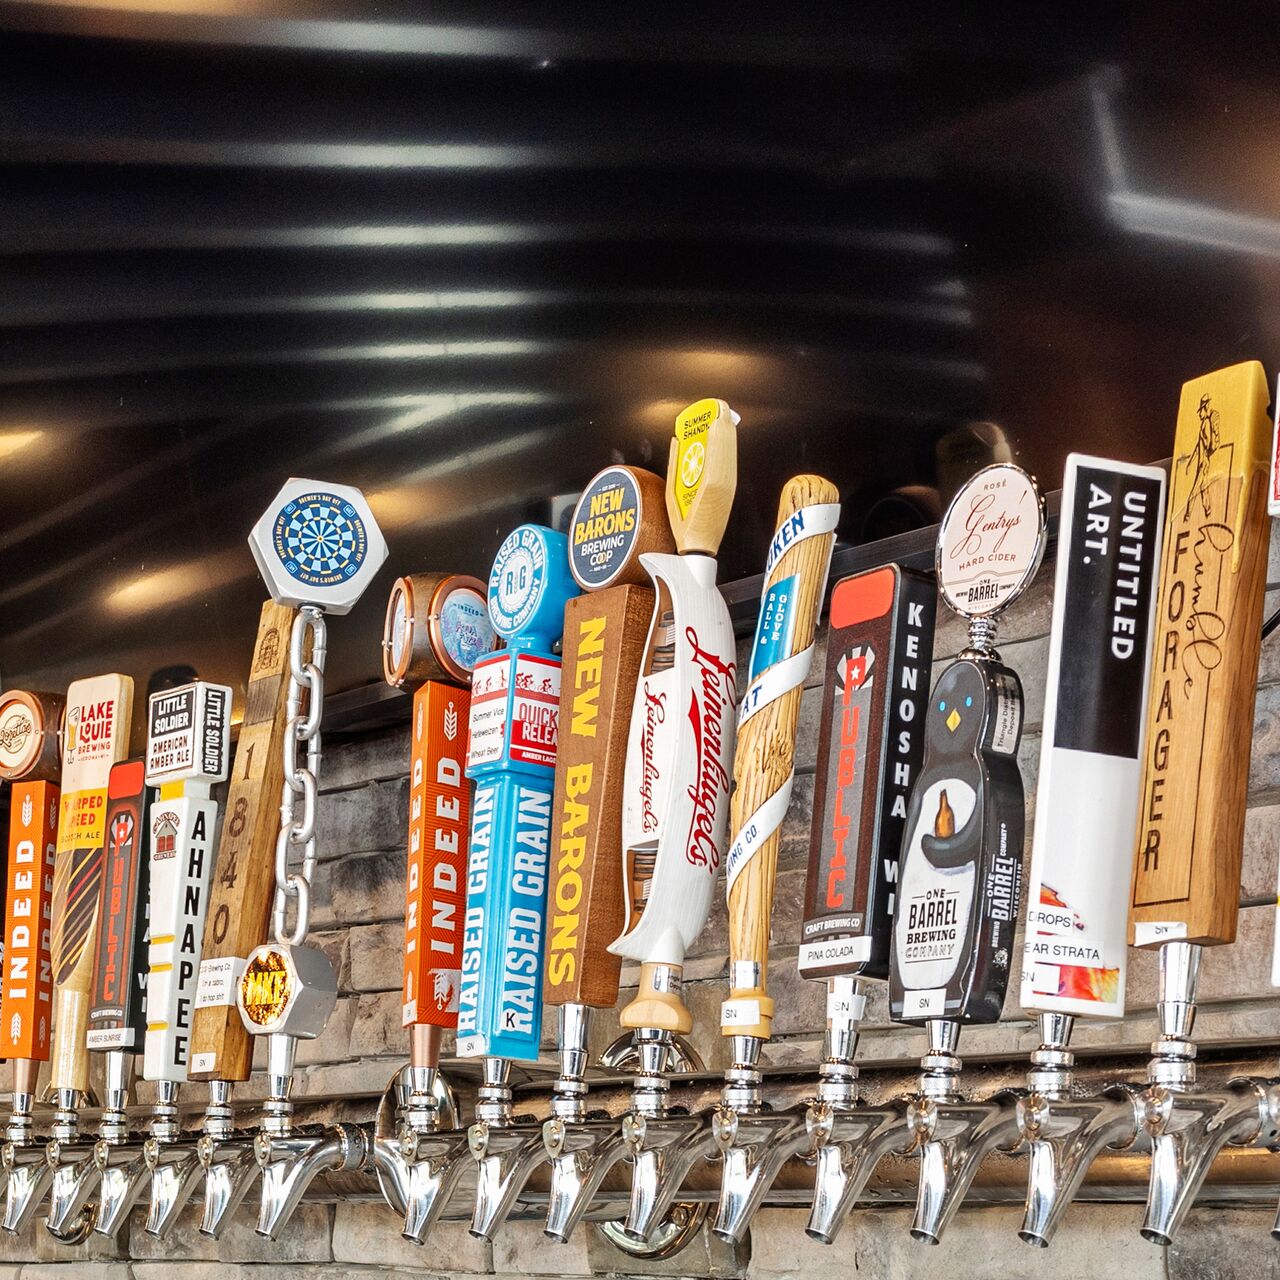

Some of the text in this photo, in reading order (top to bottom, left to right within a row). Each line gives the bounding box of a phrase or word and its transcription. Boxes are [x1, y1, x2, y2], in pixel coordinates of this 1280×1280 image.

[684, 411, 711, 430] SUMMER
[983, 478, 1006, 491] ROSÉ
[590, 487, 625, 519] NEW
[574, 508, 635, 546] BARONS
[491, 529, 545, 588] RAISED GRAIN
[581, 534, 625, 557] BREWING
[959, 553, 1017, 571] HARD CIDER
[1112, 491, 1148, 660] UNTITLED
[490, 577, 541, 630] BREWING COMPANY
[968, 583, 999, 602] BARREL
[764, 593, 776, 630] BALL
[771, 595, 788, 641] GLOVE
[81, 700, 114, 723] LAKE
[158, 694, 187, 717] LITTLE
[890, 602, 924, 820] KENOSHA
[1144, 530, 1190, 873] FORAGER
[154, 711, 189, 735] SOLDIER
[519, 702, 559, 730] QUICK
[79, 720, 113, 744] LOUIE
[204, 688, 222, 773] LITTLE SOLDIER
[78, 741, 111, 755] BREWING
[153, 735, 188, 754] AMERICAN
[150, 749, 190, 770] AMBER ALE
[826, 655, 866, 909] PUBLIC
[548, 615, 608, 987] NEW BARONS
[85, 831, 100, 840] ALE
[511, 787, 553, 897] GRAIN
[407, 757, 423, 955] INDEED
[431, 756, 461, 955] INDEED
[926, 890, 946, 900] ONE
[986, 873, 996, 898] ONE
[991, 857, 1014, 921] BARREL
[9, 840, 35, 999] INDEED
[39, 842, 57, 1002] INDEED
[103, 820, 128, 1001] PUBLIC
[458, 787, 496, 1032] RAISED GRAIN
[909, 898, 957, 929] BARREL
[1028, 911, 1071, 928] DROPS
[174, 810, 206, 1067] AHNAPEE
[805, 917, 861, 935] CRAFT BREWING CO
[906, 930, 957, 945] BREWING
[807, 945, 854, 961] PINA COLADA
[1052, 945, 1100, 960] STRATA
[724, 1009, 737, 1019] SN
[919, 998, 930, 1008] SN
[506, 1012, 516, 1030] K
